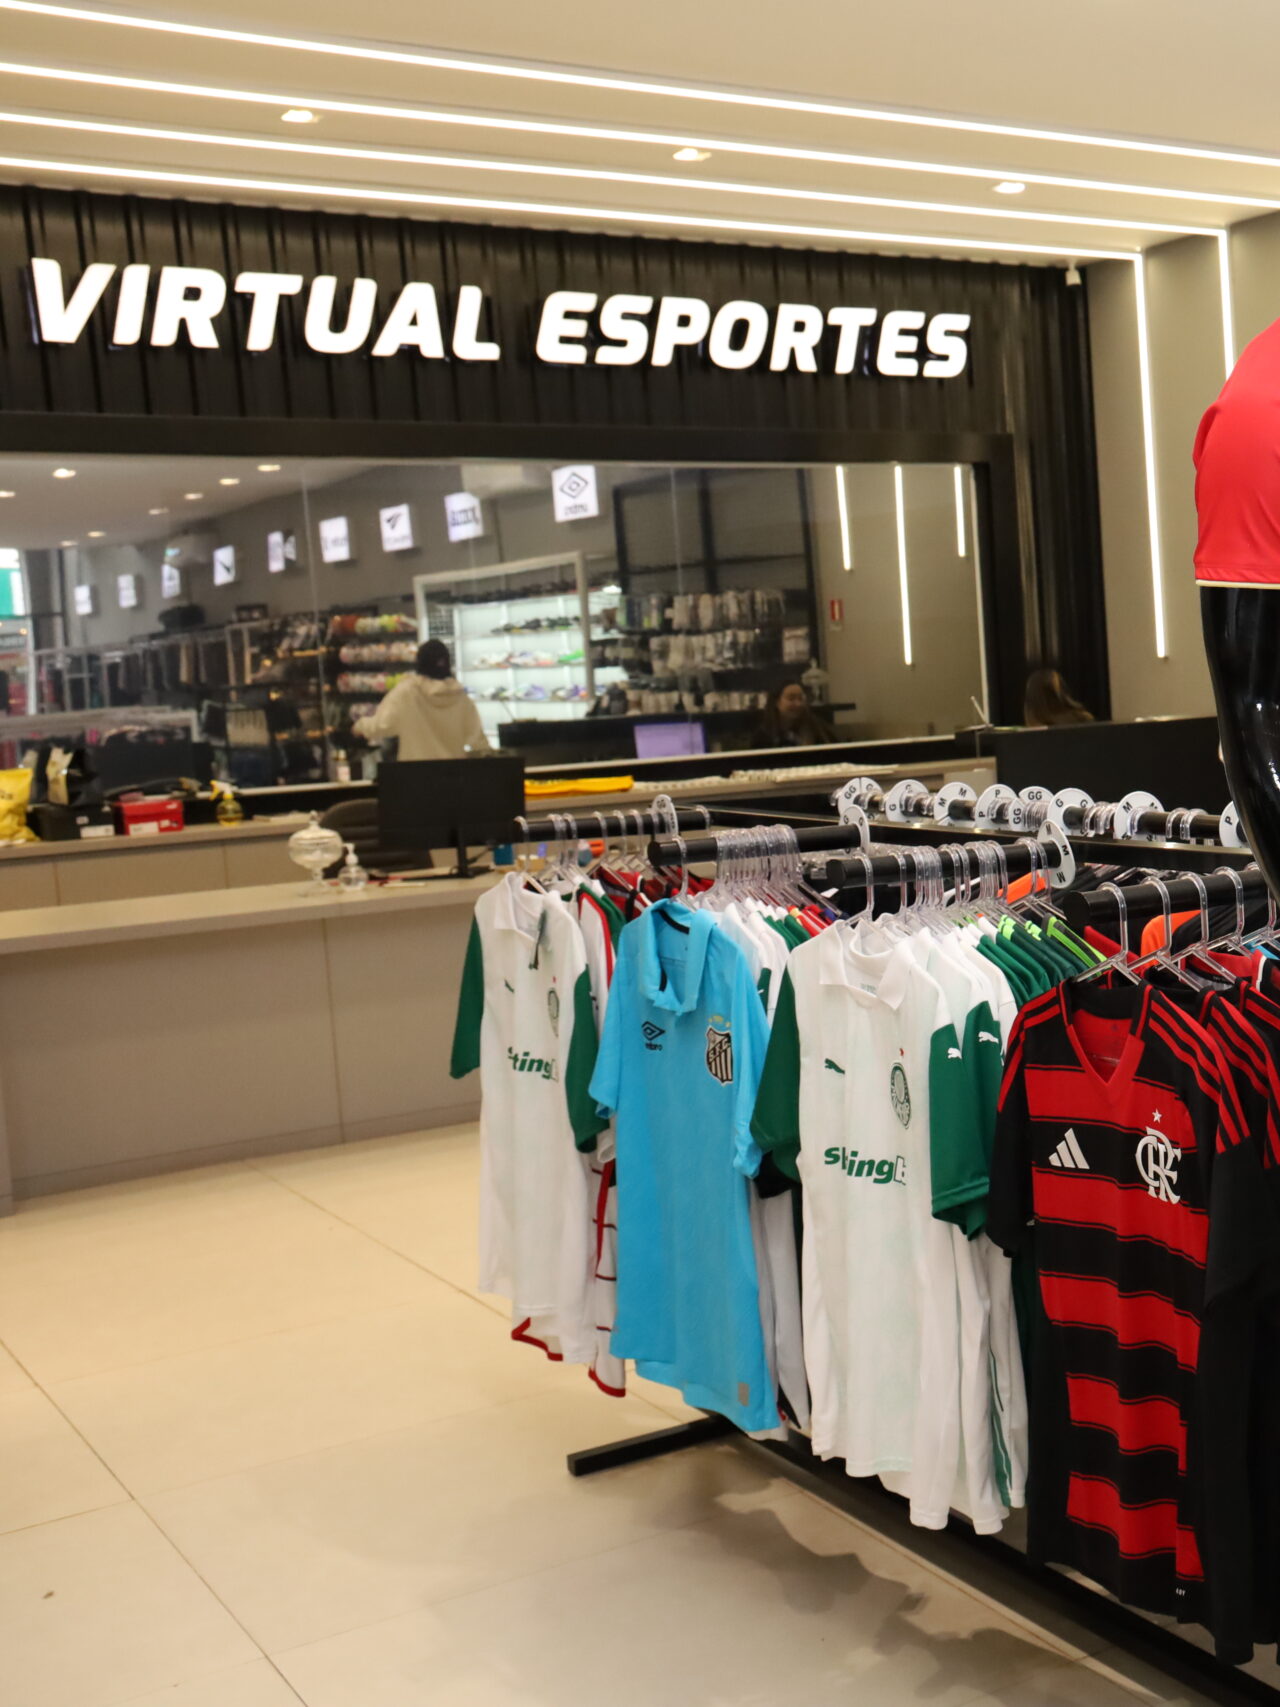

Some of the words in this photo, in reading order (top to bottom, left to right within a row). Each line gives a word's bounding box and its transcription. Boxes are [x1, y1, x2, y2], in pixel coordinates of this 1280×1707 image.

[31, 257, 500, 361] VIRTUAL
[535, 291, 971, 378] ESPORTES
[1028, 791, 1043, 800] GG
[889, 803, 897, 811] G
[1056, 799, 1064, 808] G
[1123, 802, 1133, 813] M
[1013, 808, 1022, 825] GG
[1225, 816, 1233, 826] P
